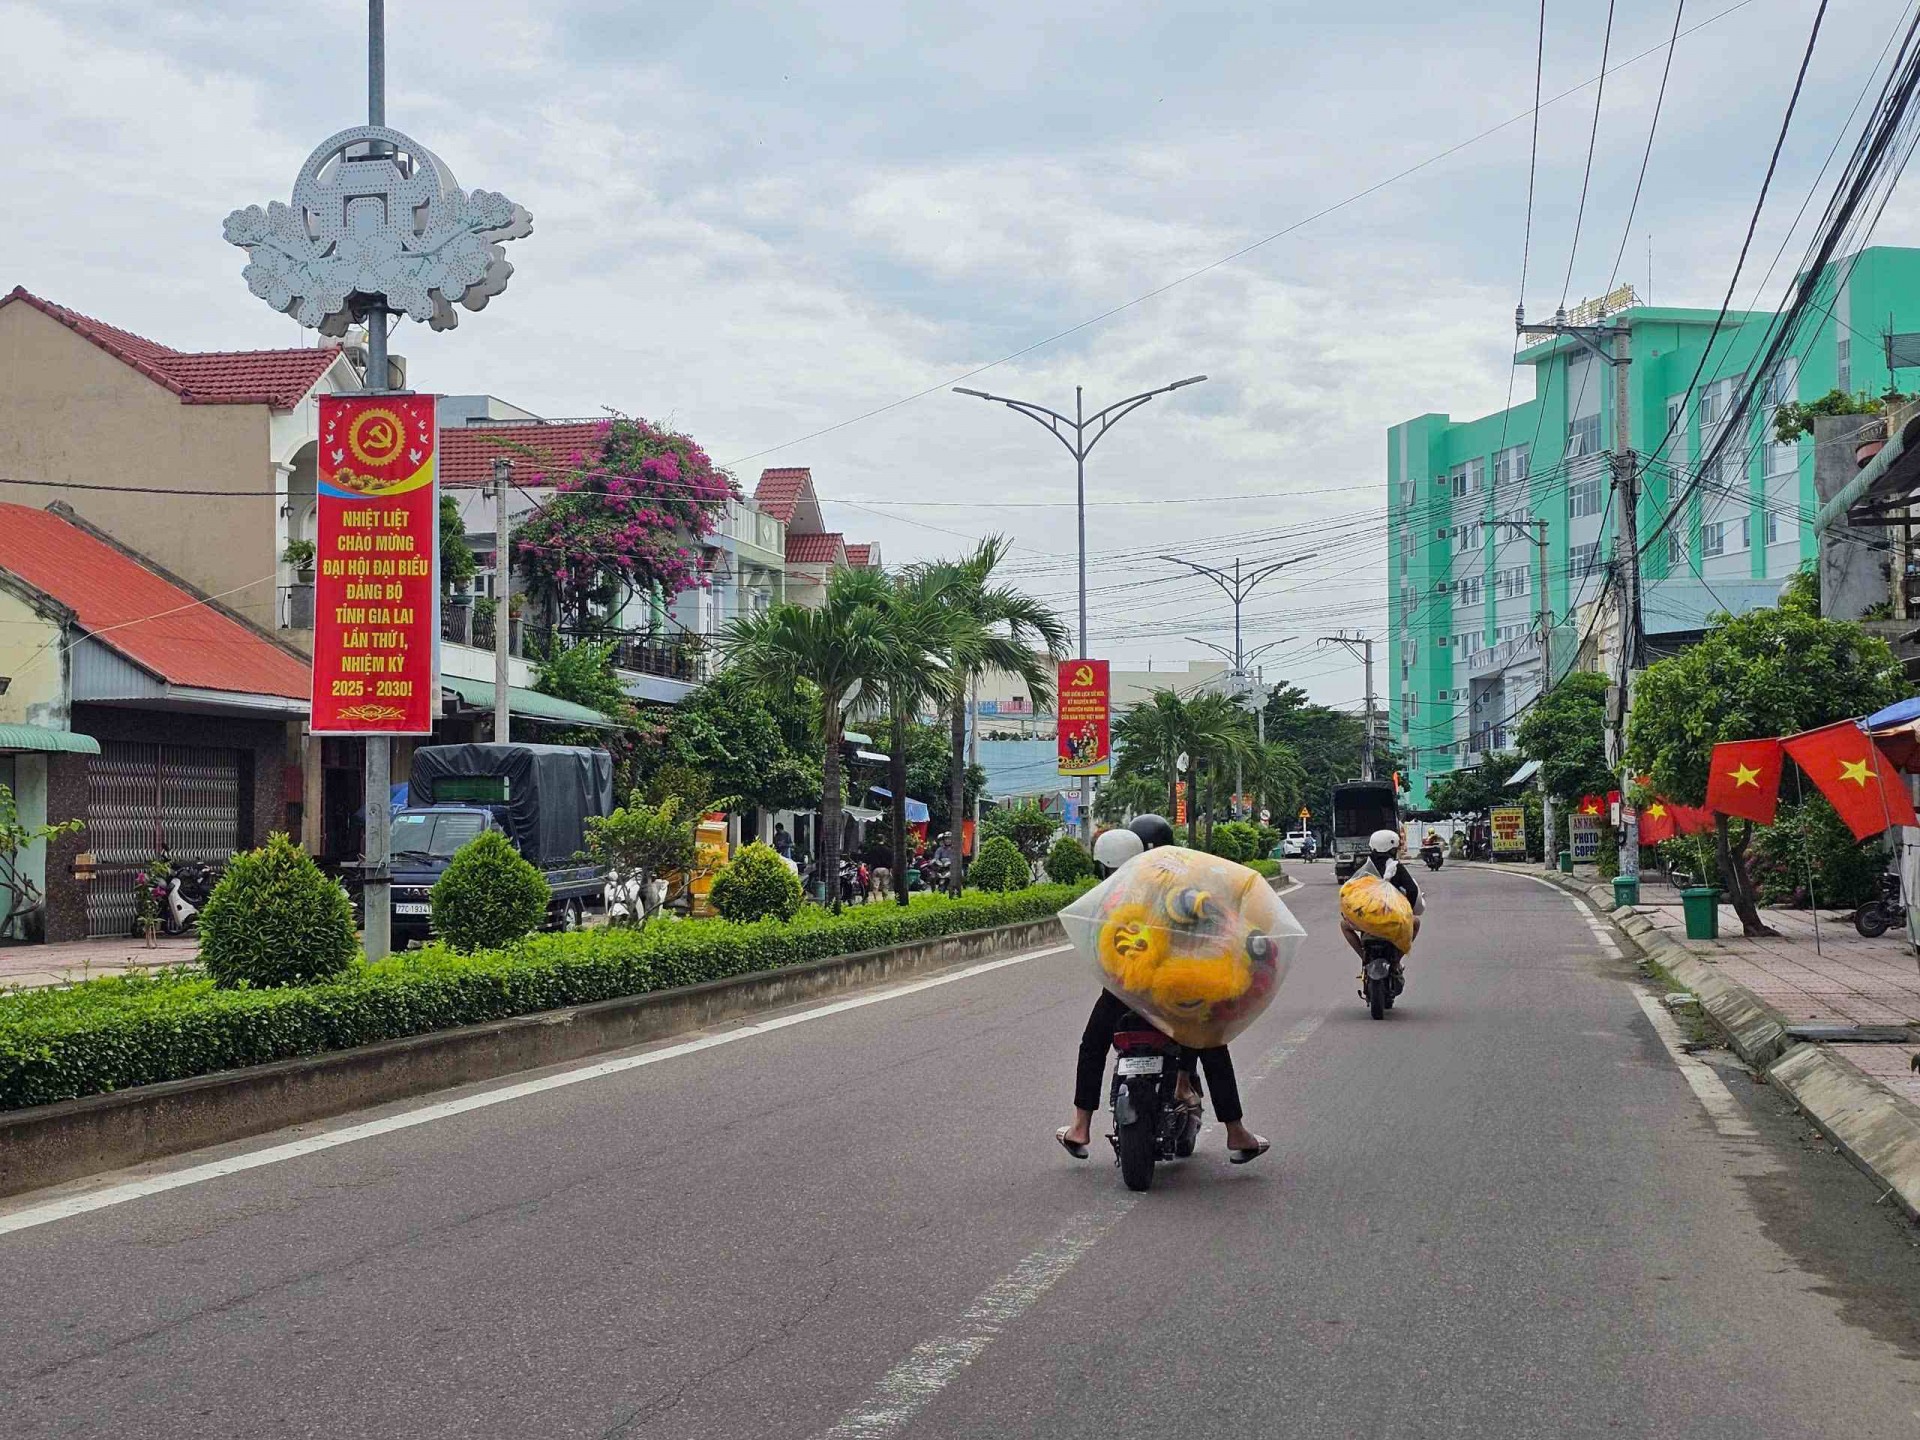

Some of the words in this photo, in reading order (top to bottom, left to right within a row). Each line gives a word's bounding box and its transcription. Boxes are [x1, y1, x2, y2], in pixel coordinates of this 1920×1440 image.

[343, 508, 380, 530] NHIỆT
[383, 508, 409, 530] LIỆT
[338, 532, 372, 551] CHÀO
[376, 532, 414, 551] MỪNG
[323, 559, 344, 579] ĐẠI
[348, 556, 370, 579] HỘI
[373, 559, 395, 579] ĐẠI
[398, 553, 428, 576] BIỂU
[346, 579, 382, 600] ĐẢNG
[386, 580, 403, 603] BỘ
[336, 603, 365, 624] TỈNH
[368, 608, 391, 624] GIA
[393, 608, 414, 624] LAI
[343, 627, 368, 648] LẦN
[371, 629, 398, 648] THỨ
[341, 653, 384, 675] NHIỆM
[332, 680, 364, 696] 2025
[376, 680, 412, 696] 2030!
[1574, 832, 1599, 844] PHOTO
